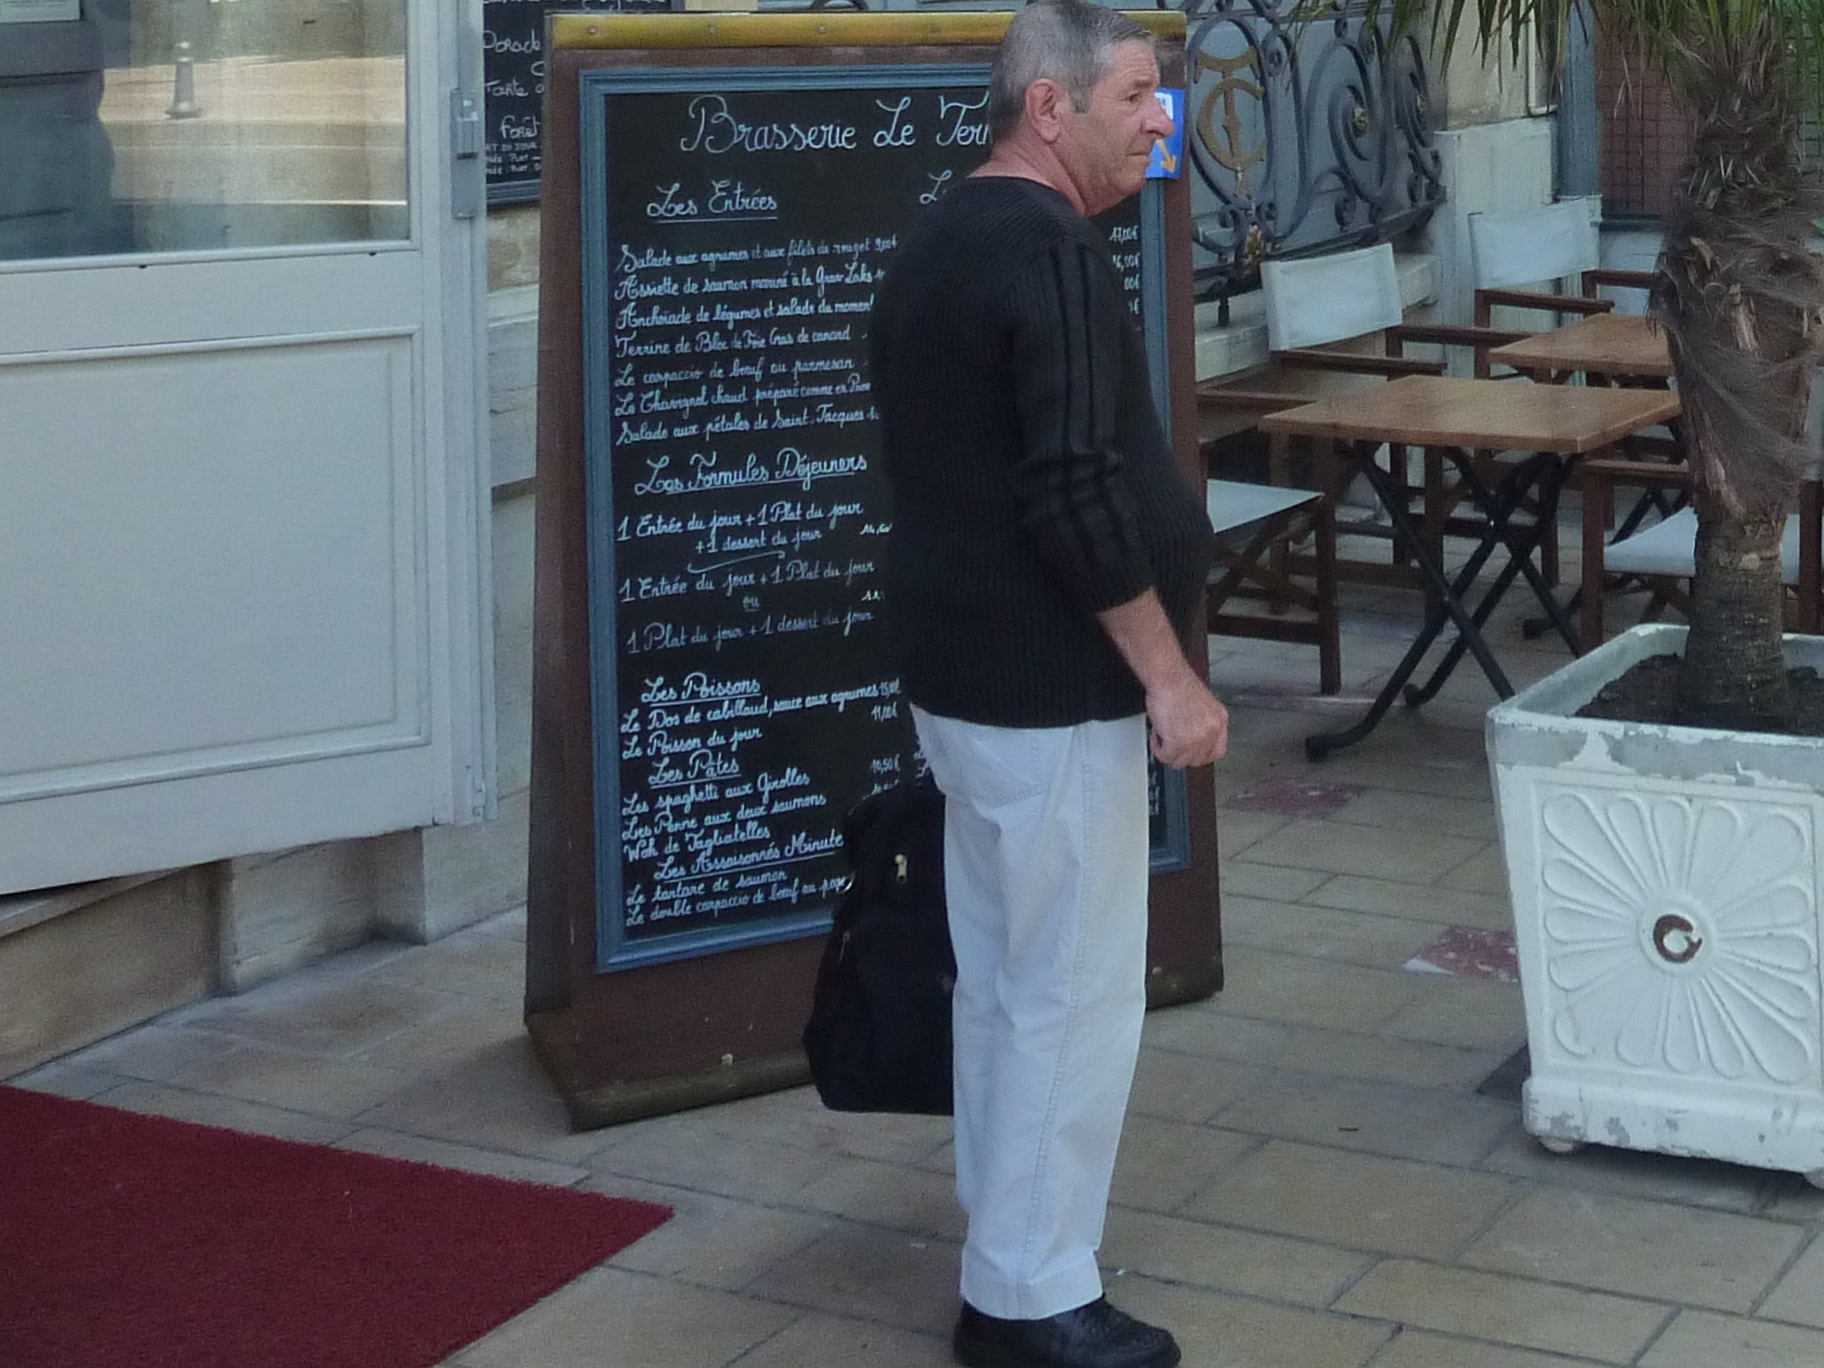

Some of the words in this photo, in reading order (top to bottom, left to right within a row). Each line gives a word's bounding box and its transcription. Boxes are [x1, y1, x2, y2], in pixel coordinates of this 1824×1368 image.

[680, 94, 857, 154] Brasserie
[873, 96, 917, 147] Le
[935, 90, 990, 147] Ter
[646, 182, 699, 217] Les
[708, 179, 778, 214] Entrées
[615, 244, 672, 273] Salade
[675, 255, 699, 266] aux
[614, 274, 679, 301] Assiette
[684, 276, 699, 294] de
[702, 280, 749, 294] saumon
[697, 305, 713, 323] de
[714, 304, 762, 330] légumes
[777, 297, 816, 316] salade
[615, 330, 671, 358] Terrine
[676, 334, 692, 353] de
[797, 327, 811, 343] de
[812, 323, 852, 343] canard
[614, 363, 636, 388] Le
[644, 368, 704, 390] carpaccio
[710, 360, 725, 378] de
[793, 359, 856, 382] parmesan
[711, 384, 749, 405] chaud
[616, 421, 669, 446] Salade
[673, 424, 699, 437] aux
[706, 412, 751, 441] pétales
[754, 413, 769, 430] de
[635, 455, 685, 496] Les
[688, 451, 771, 491] Formules
[775, 447, 869, 491] Déjeuners
[636, 513, 684, 538] Entrée
[688, 512, 706, 532] du
[709, 509, 742, 543] jour
[806, 502, 823, 521] du
[827, 499, 864, 530] jour
[722, 530, 768, 551] dessert
[771, 529, 788, 546] du
[791, 527, 822, 552] jour
[638, 572, 688, 599] Entrée
[695, 571, 715, 590] du
[721, 570, 756, 597] jour
[785, 560, 820, 581] Plat
[822, 560, 840, 579] du
[843, 558, 875, 587] jour
[642, 622, 687, 651] Plat
[691, 625, 709, 644] du
[713, 624, 743, 653] jour
[776, 609, 819, 634] dessert
[842, 606, 874, 638] jour
[642, 676, 678, 704] Les
[681, 672, 762, 700] Poissons
[621, 709, 641, 734] Le
[651, 709, 680, 732] Dos
[684, 705, 701, 725] de
[805, 692, 828, 706] aux
[831, 683, 879, 713] agrumes
[622, 735, 643, 760] Le
[650, 730, 702, 755] Poisson
[707, 730, 726, 746] du
[731, 725, 763, 753] jour
[648, 757, 684, 785] Les
[622, 792, 650, 816] Les
[654, 784, 720, 814] spaghetti
[725, 783, 754, 799] aux
[757, 767, 812, 805] Girolles
[621, 815, 652, 841] Les
[653, 810, 699, 836] Penne
[704, 812, 732, 827] aux
[737, 804, 767, 821] deux
[770, 794, 828, 814] saumons
[655, 856, 687, 881] Les
[785, 828, 845, 857] Minute
[664, 836, 680, 854] de
[685, 821, 771, 857] Tagliatelles
[626, 883, 646, 907] Le
[651, 872, 706, 903] tartare
[712, 877, 730, 892] de
[735, 871, 788, 889] saumon
[626, 905, 646, 928] Le
[650, 899, 693, 922] double
[753, 888, 767, 904] de
